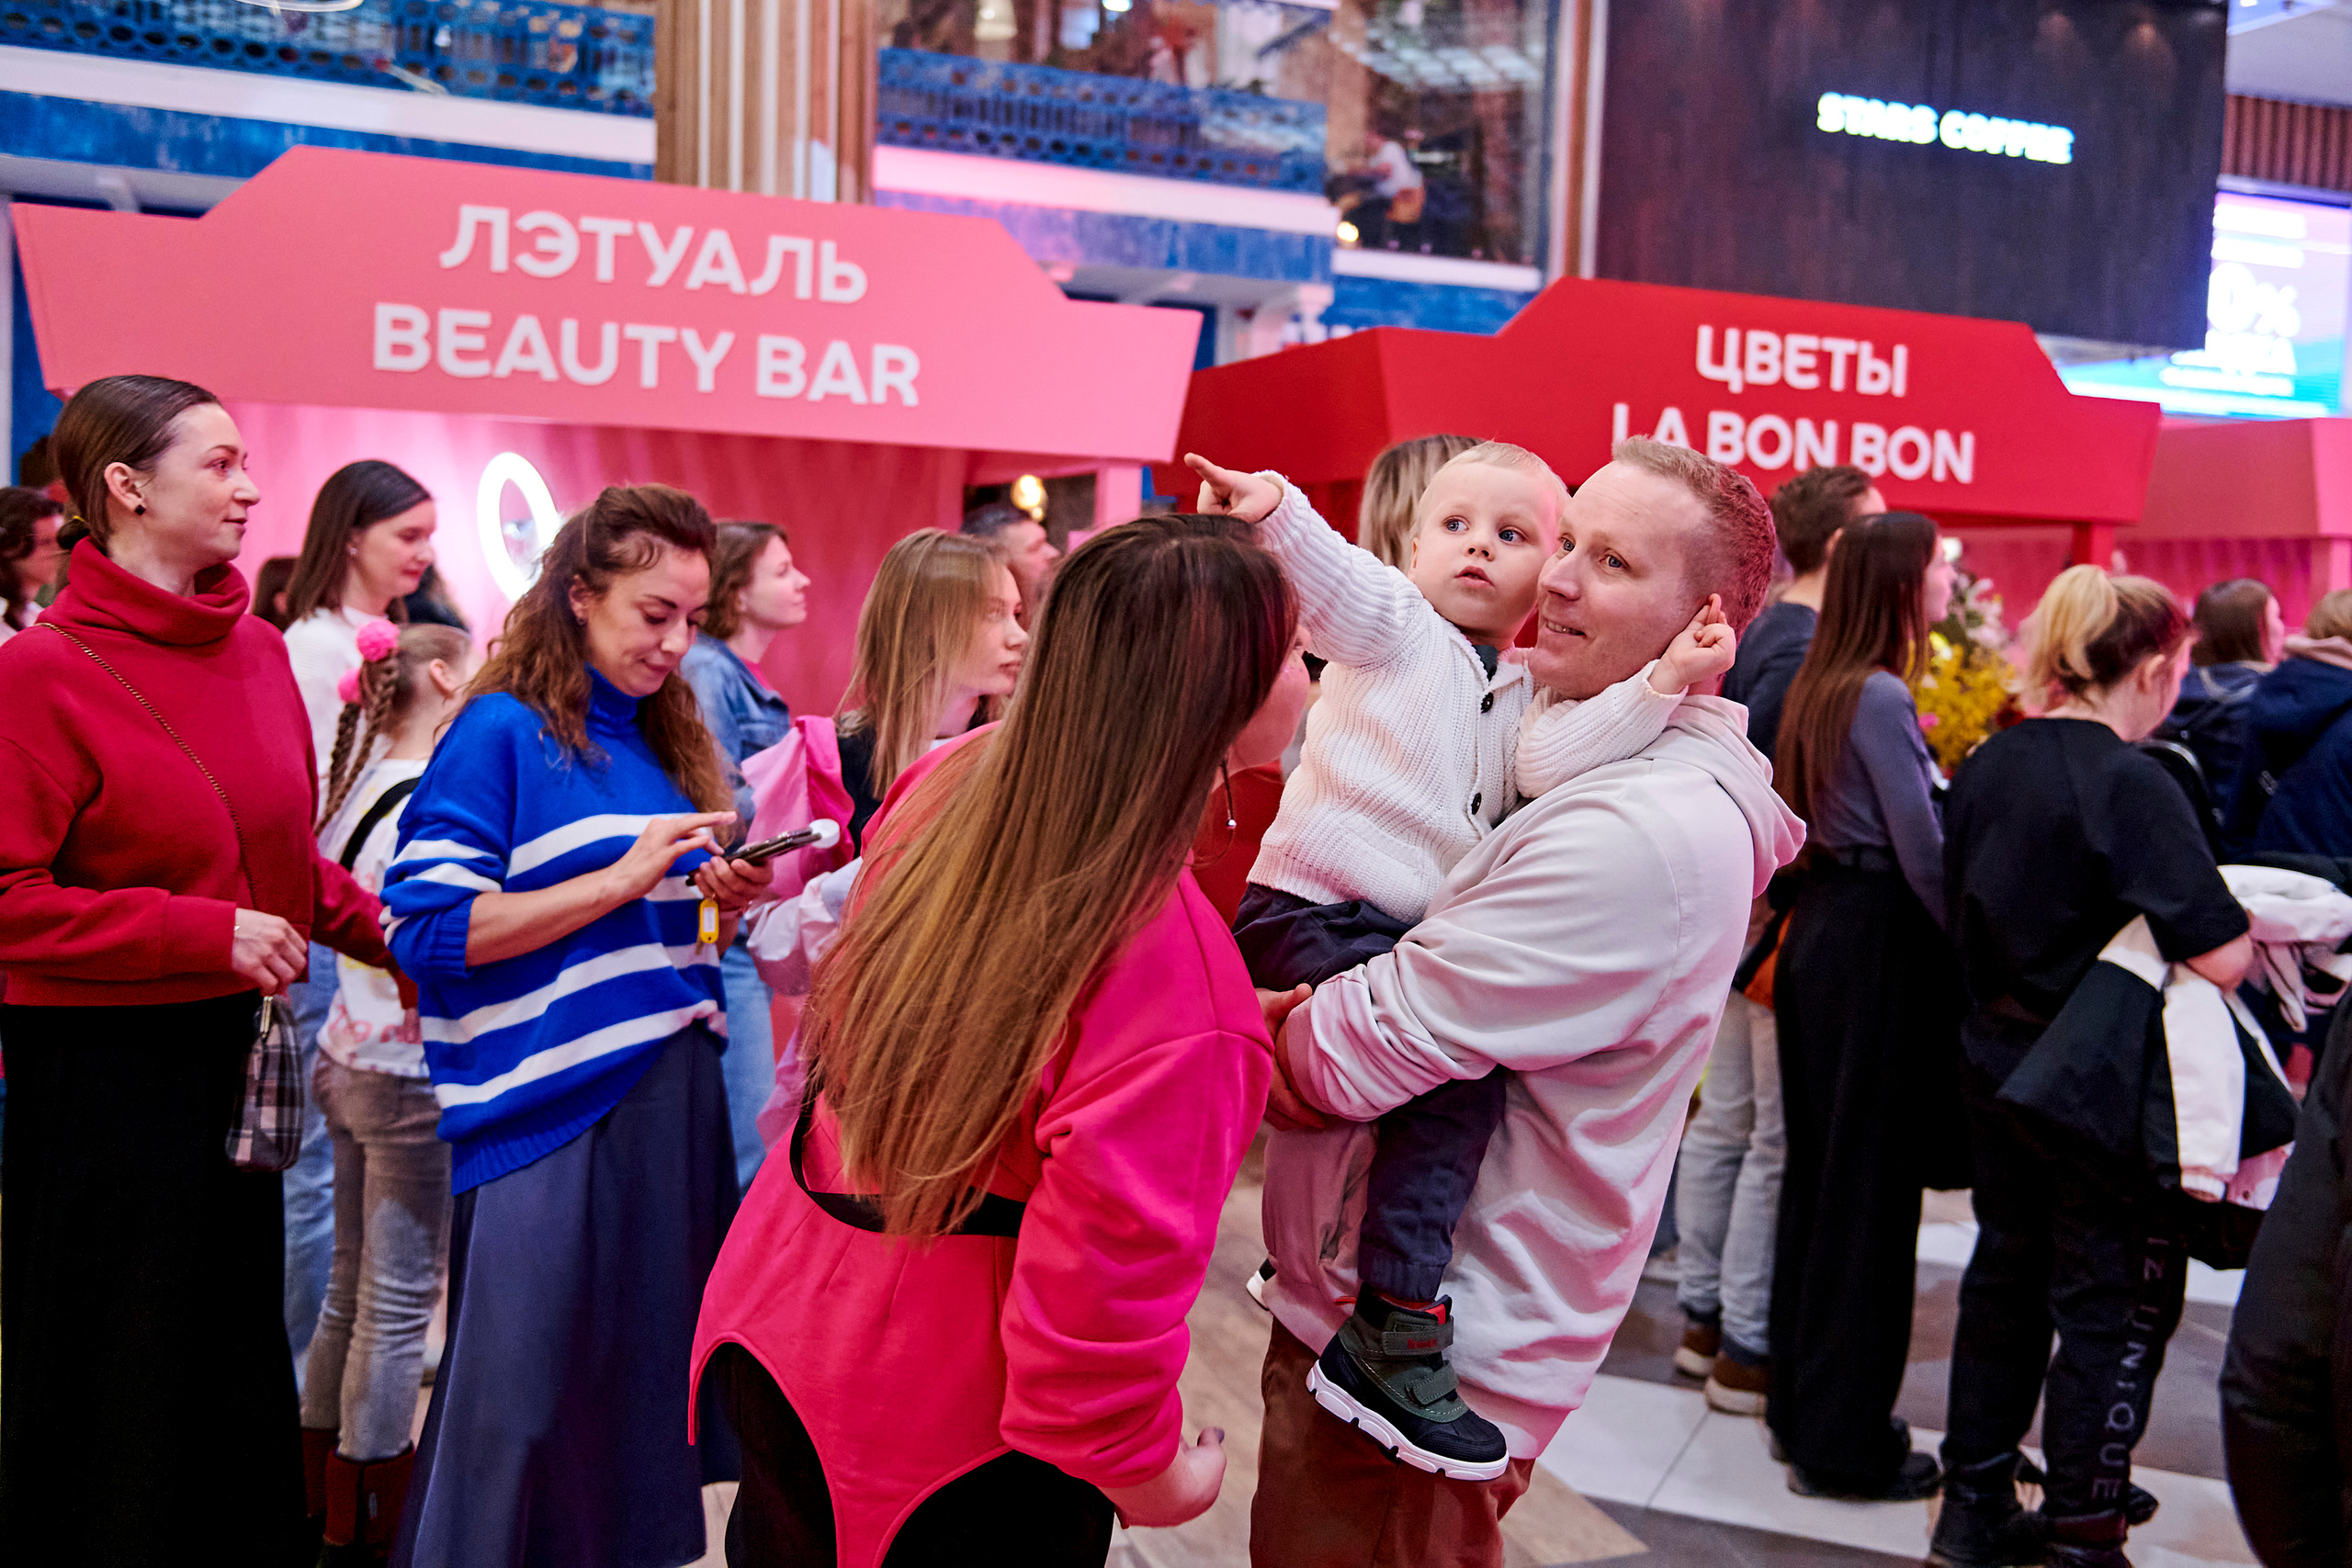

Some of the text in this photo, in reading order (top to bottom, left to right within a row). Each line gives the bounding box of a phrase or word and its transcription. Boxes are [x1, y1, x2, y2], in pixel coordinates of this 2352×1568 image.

[439, 204, 868, 303] ЛЭТУАЛЬ
[373, 302, 921, 407] BEAUTY BAR
[1695, 324, 1908, 398] ЦВЕТЫ
[1707, 410, 1838, 471] BON
[1850, 423, 1974, 484] BON
